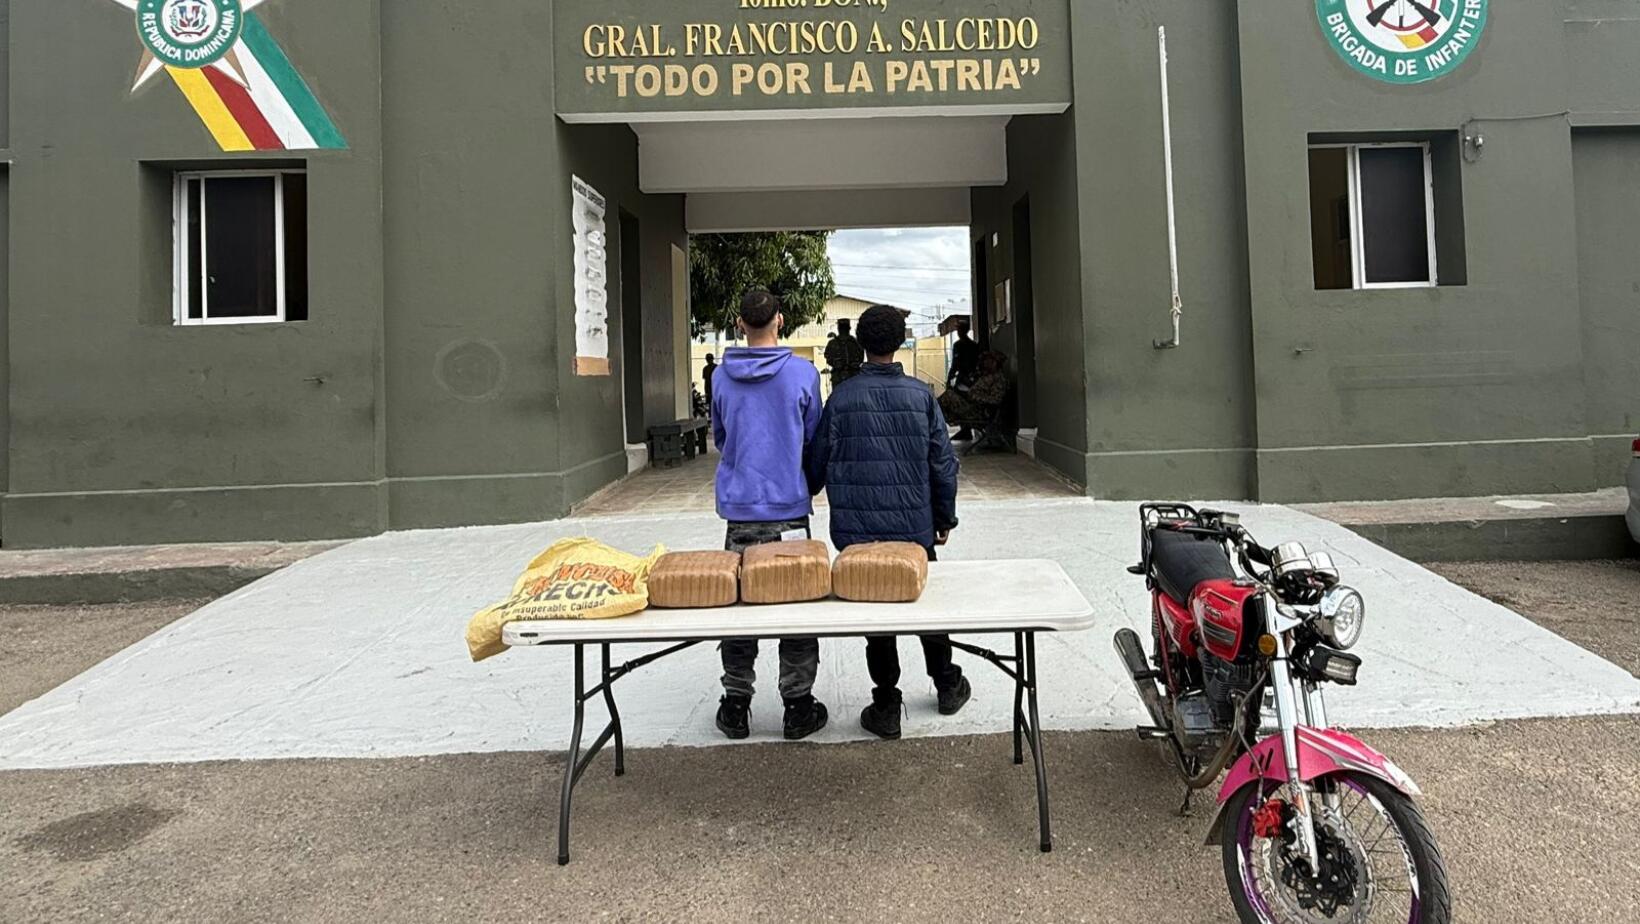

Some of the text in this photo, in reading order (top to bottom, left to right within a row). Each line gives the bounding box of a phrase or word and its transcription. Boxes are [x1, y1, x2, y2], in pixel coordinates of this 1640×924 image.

[142, 9, 235, 61] REPUBLICA DOMINICANA
[583, 17, 1039, 57] GRAL. FRANCISCO A. SALCEDO
[1327, 12, 1387, 74] BRIGADA
[1395, 58, 1418, 75] DE
[732, 62, 812, 95] POR
[824, 61, 873, 93] LA
